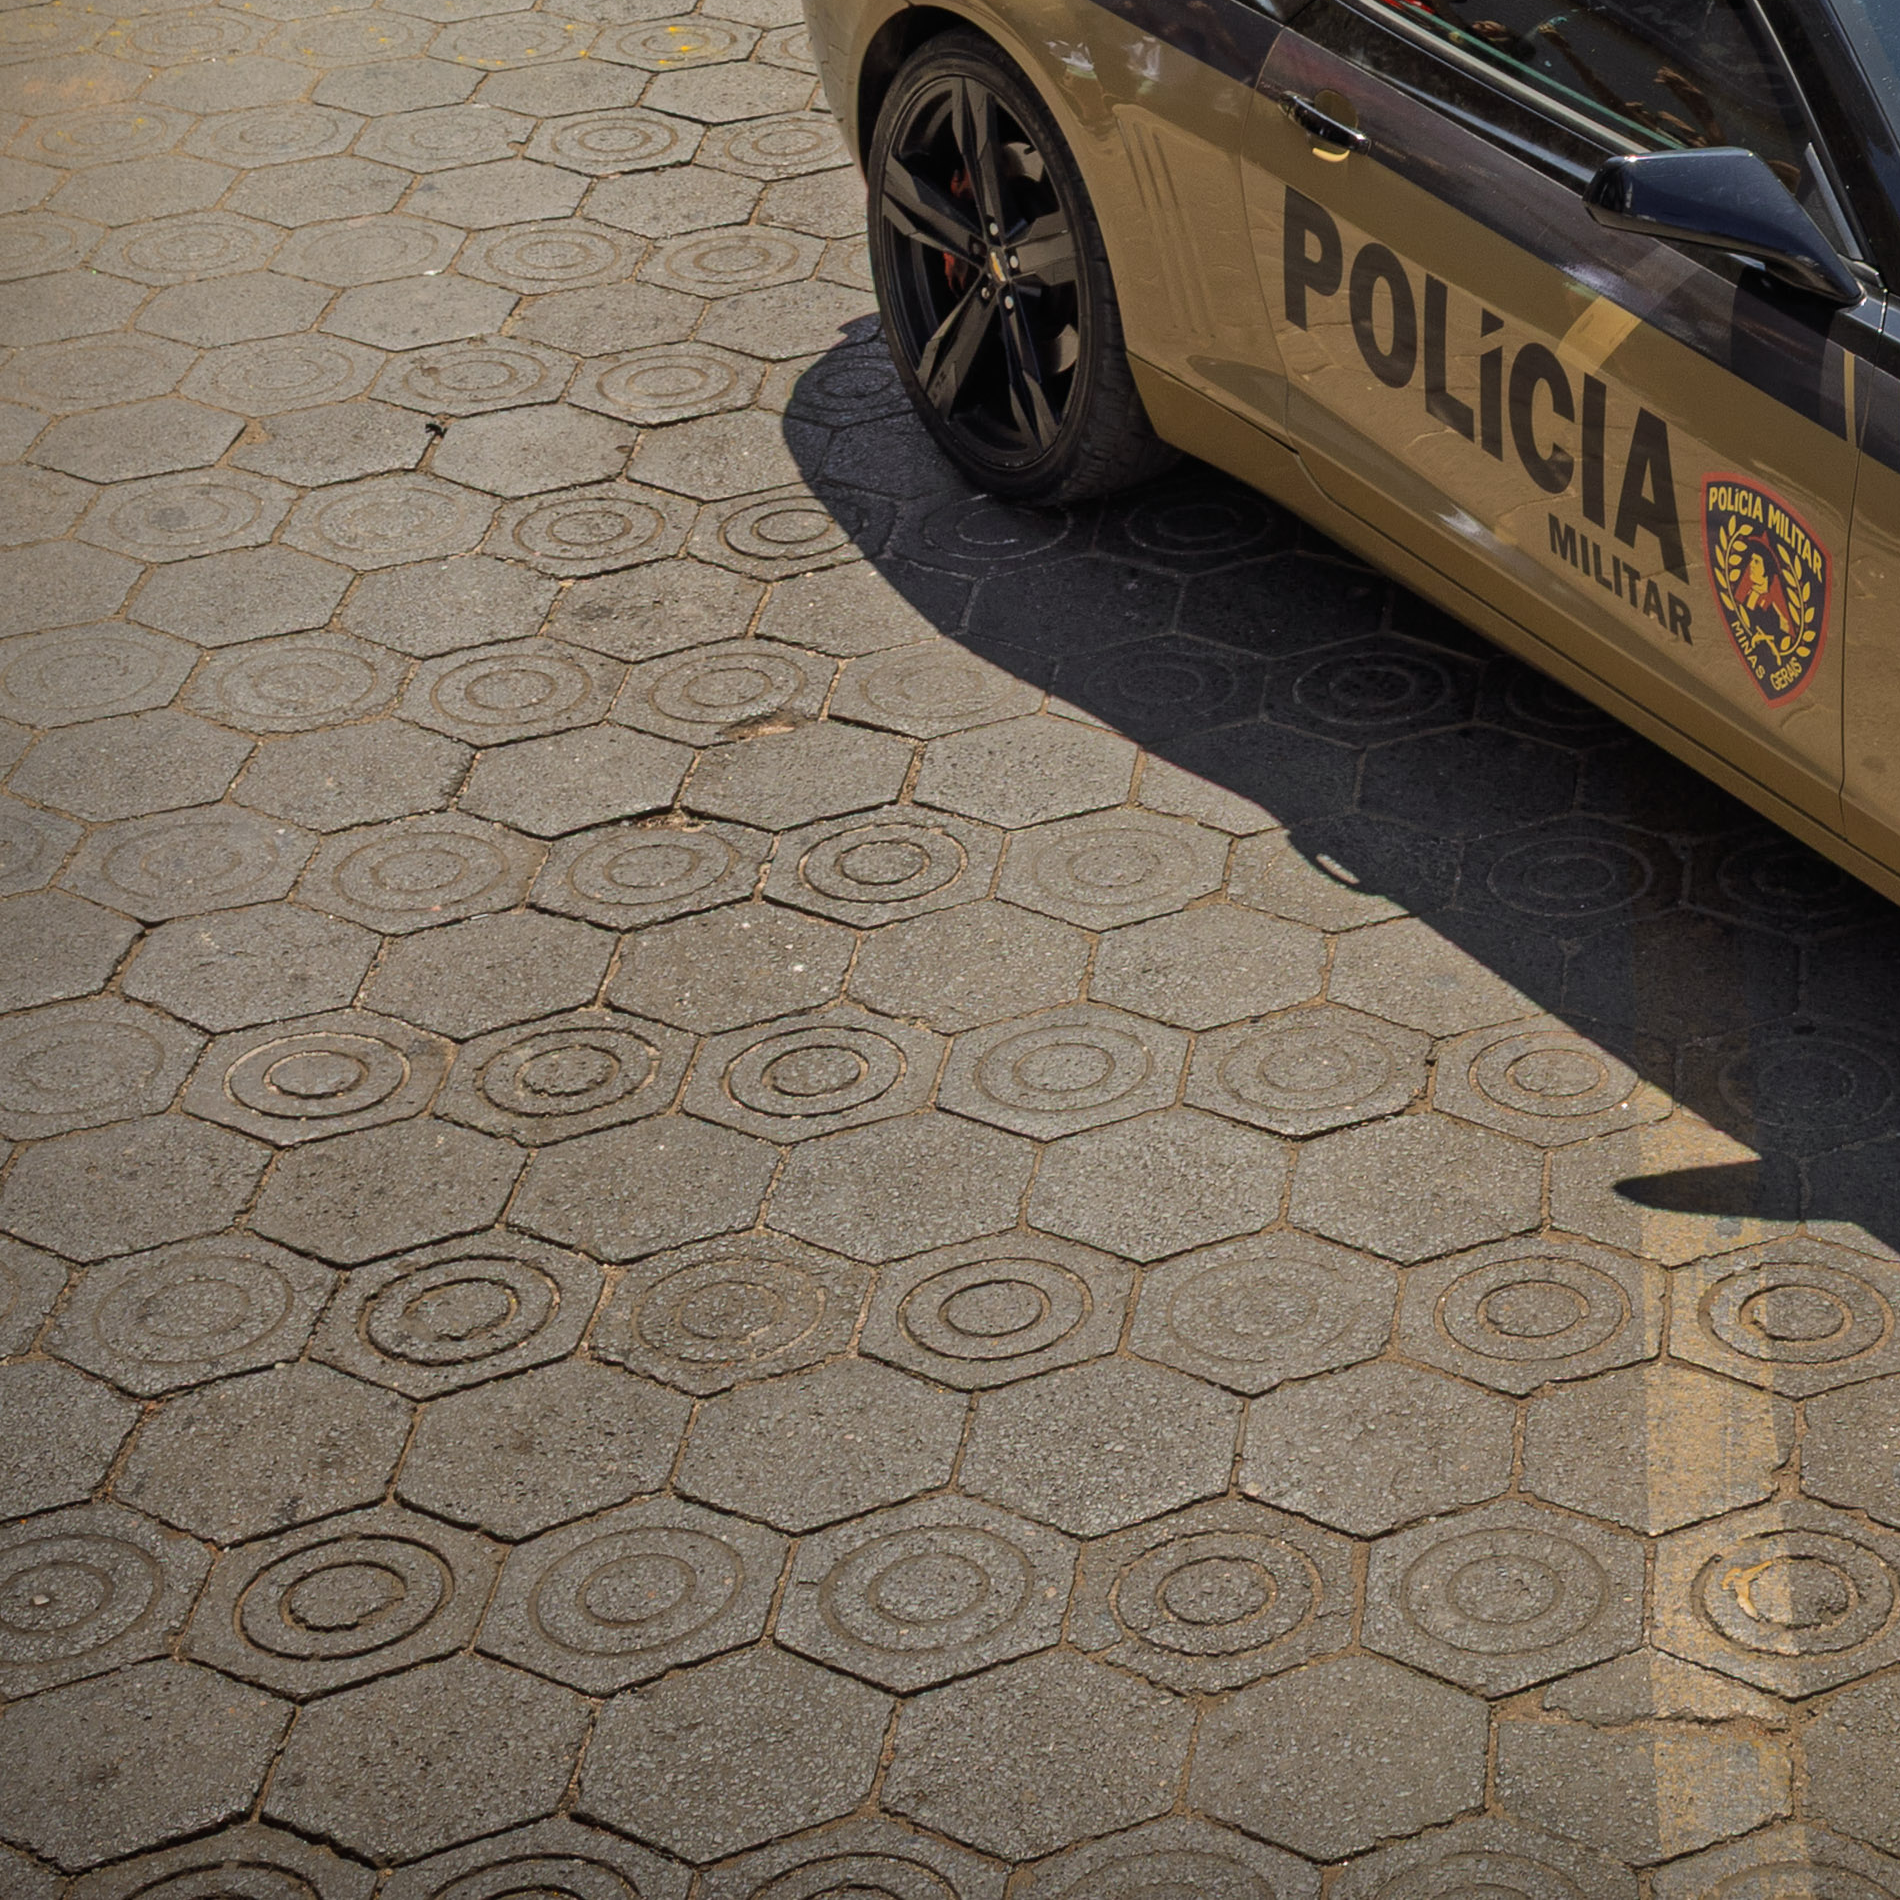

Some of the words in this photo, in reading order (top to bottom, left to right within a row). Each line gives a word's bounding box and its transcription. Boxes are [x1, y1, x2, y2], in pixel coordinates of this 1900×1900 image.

[1547, 512, 1694, 646] MILITAR
[1767, 503, 1824, 584] MILITAR
[1730, 620, 1767, 681] MINAS
[1769, 655, 1803, 692] GERAIS
